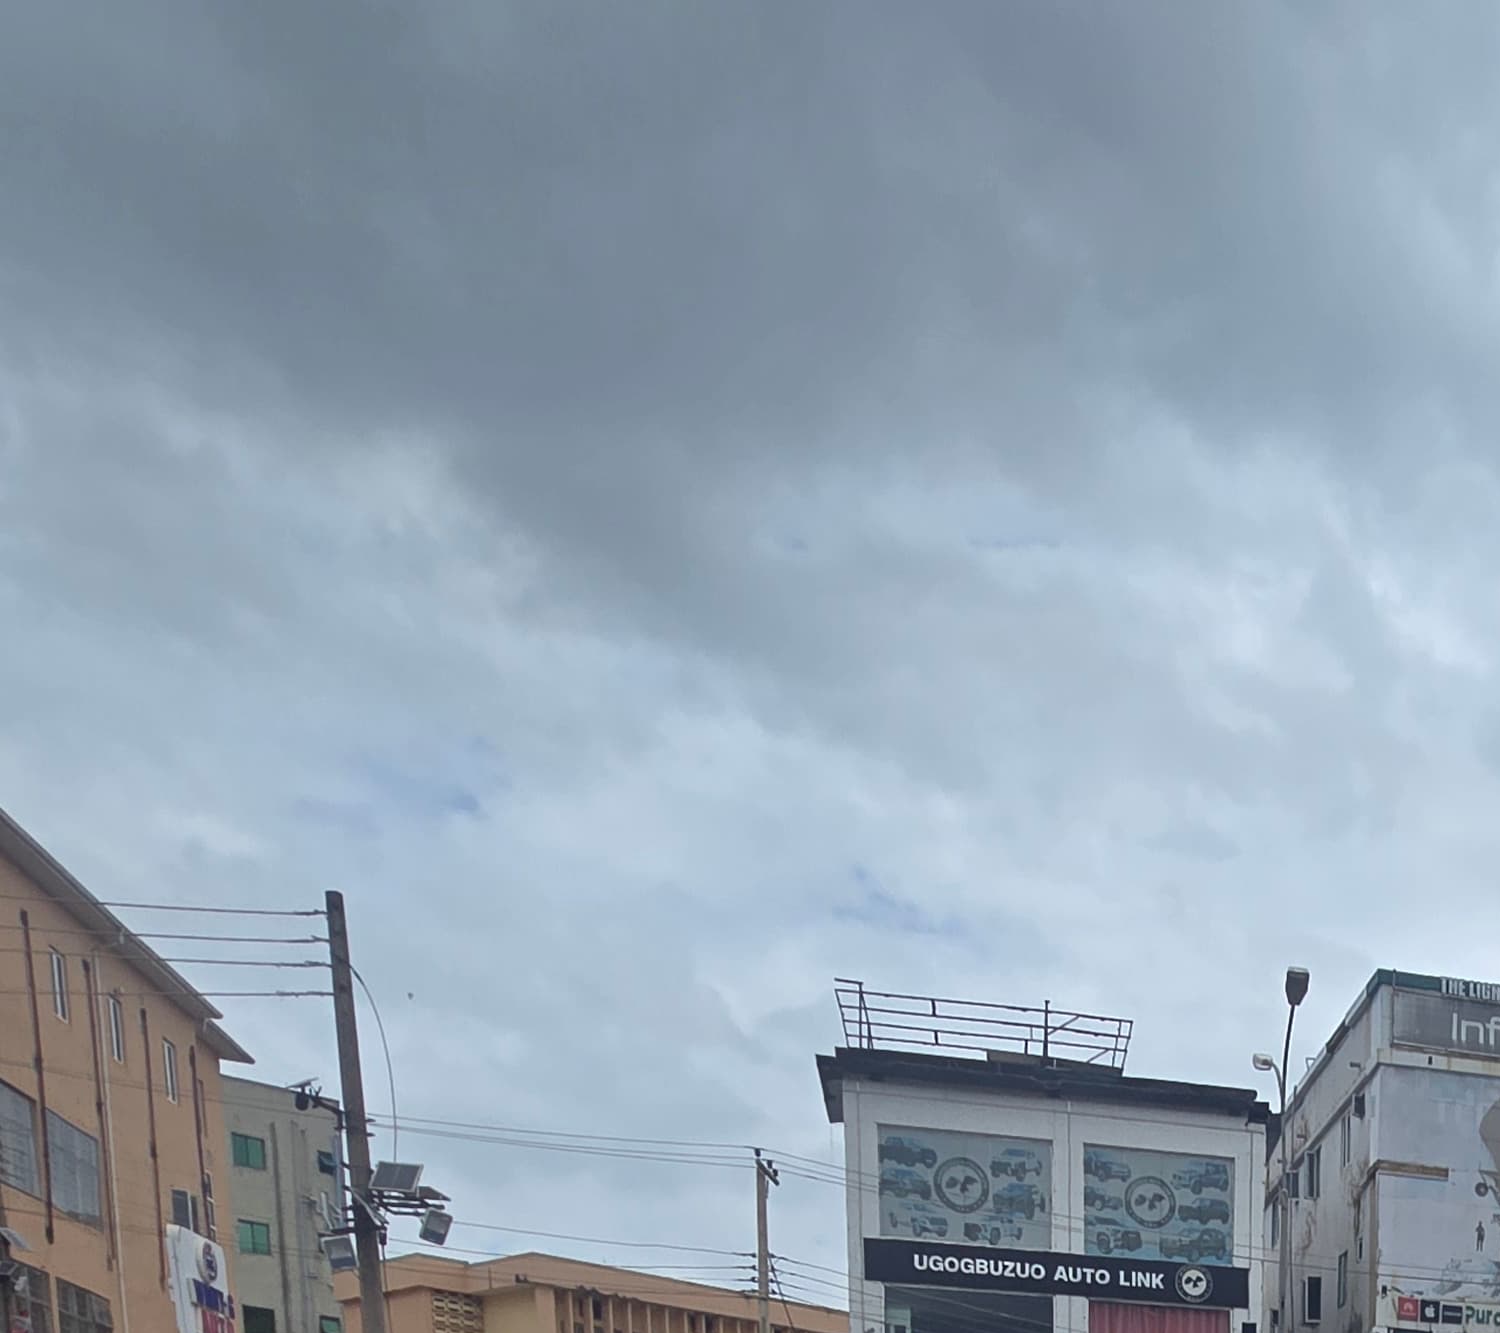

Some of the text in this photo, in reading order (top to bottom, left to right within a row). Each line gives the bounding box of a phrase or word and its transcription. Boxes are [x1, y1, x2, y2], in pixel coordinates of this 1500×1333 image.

[1440, 977, 1466, 997] THE
[913, 1253, 1046, 1280] UGOGBUZUO
[1053, 1265, 1111, 1285] AUTO
[1119, 1269, 1165, 1290] LINK
